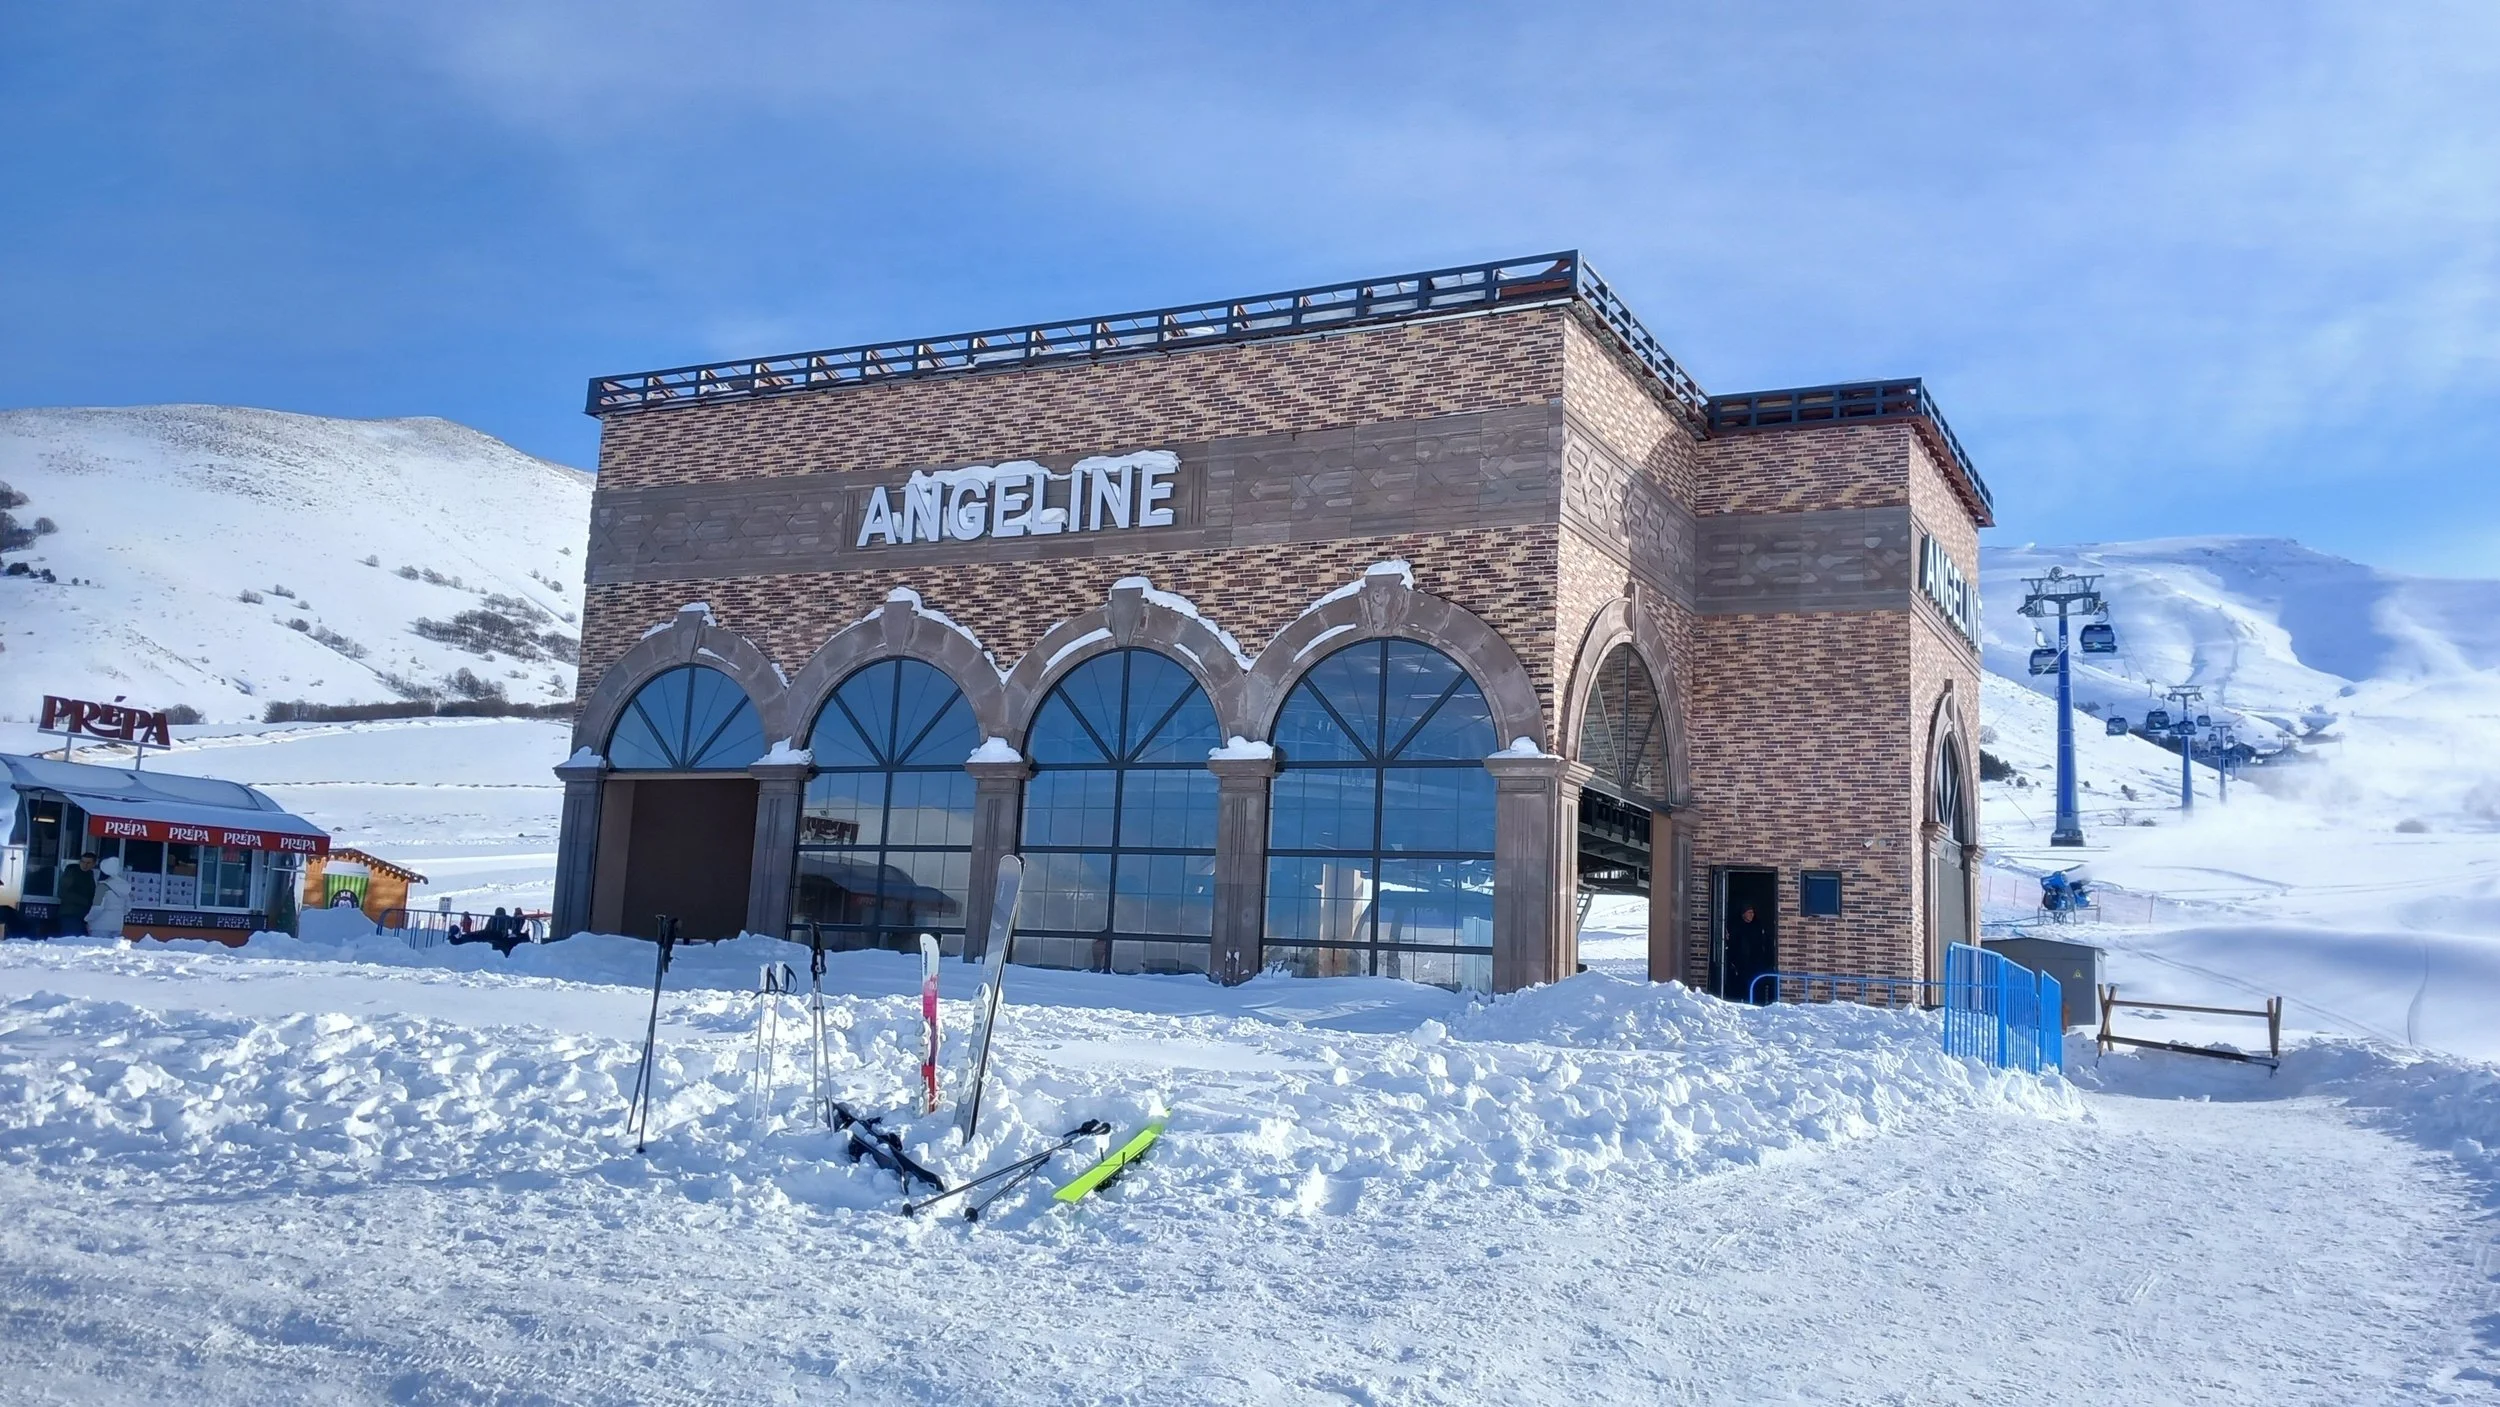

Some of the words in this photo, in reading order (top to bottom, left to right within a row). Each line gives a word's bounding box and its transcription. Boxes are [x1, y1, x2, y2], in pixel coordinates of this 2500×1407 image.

[856, 463, 1176, 547] ANGELINE
[1925, 534, 1983, 653] ANGELINE
[39, 695, 171, 746] PRÉPA
[104, 820, 148, 837] PRÉPA
[168, 825, 210, 842] PRÉPA
[223, 830, 262, 847] PRÉPA
[280, 836, 316, 852] PRÉPA
